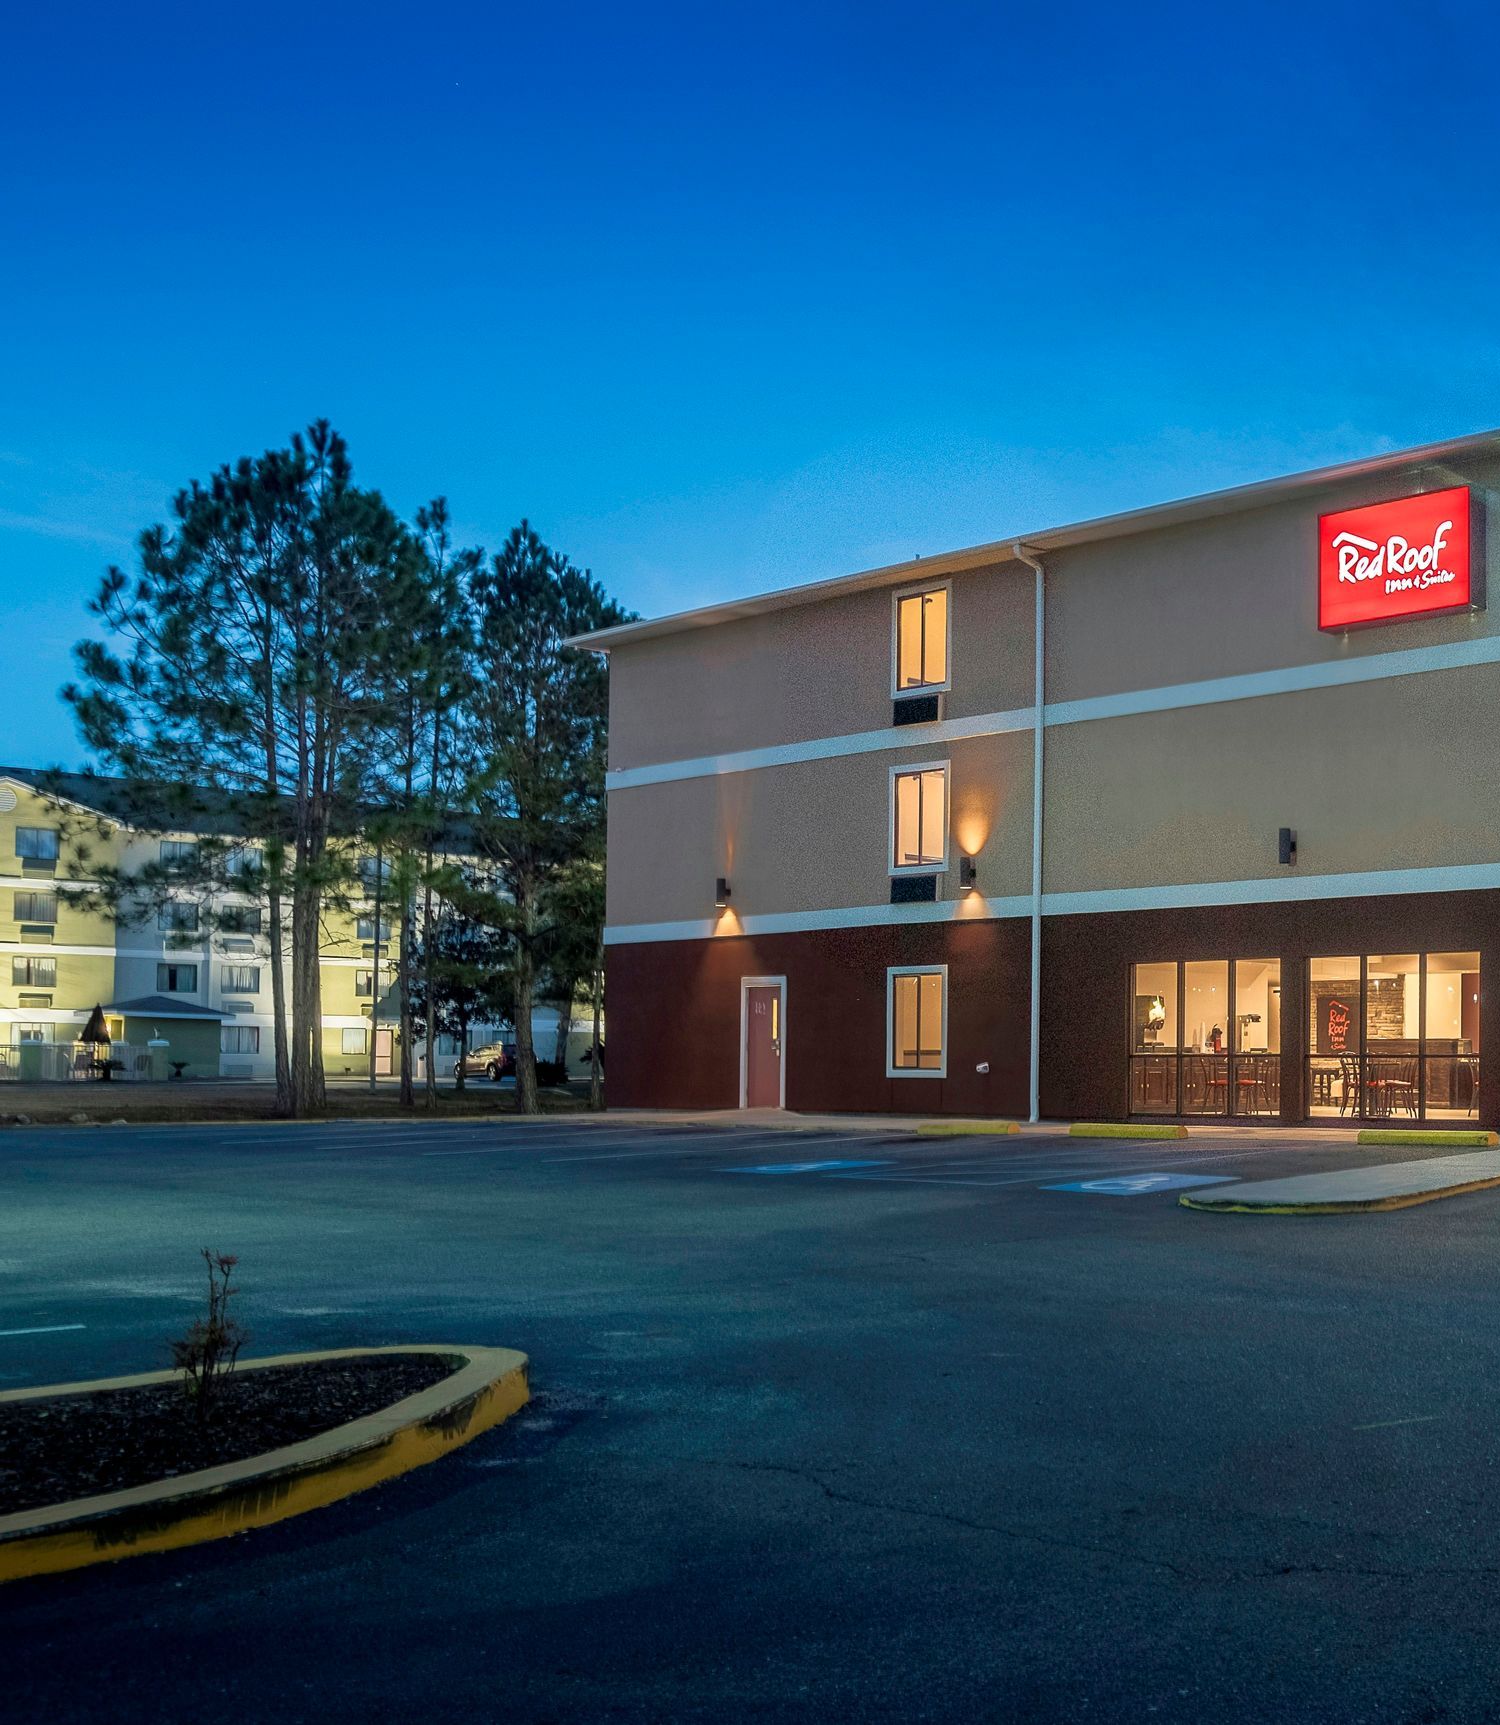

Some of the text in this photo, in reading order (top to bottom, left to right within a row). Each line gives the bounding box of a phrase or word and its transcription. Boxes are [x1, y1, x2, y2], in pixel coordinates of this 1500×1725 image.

[1338, 520, 1453, 583] Red Roof
[1330, 1009, 1346, 1023] Red
[1328, 1020, 1350, 1036] Roof
